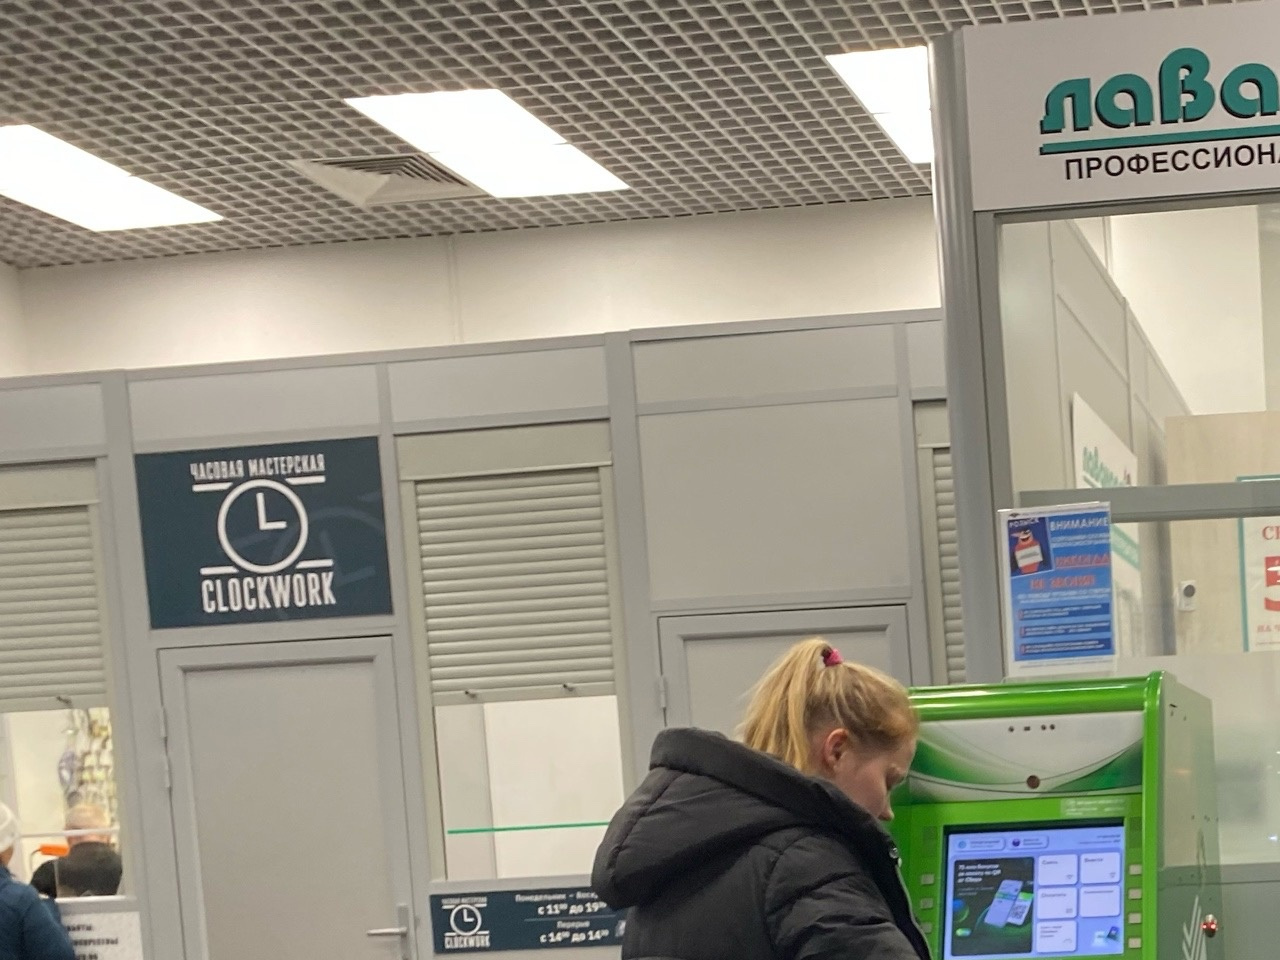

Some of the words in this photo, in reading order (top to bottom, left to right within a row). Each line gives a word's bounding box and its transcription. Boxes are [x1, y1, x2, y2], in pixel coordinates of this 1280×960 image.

[190, 460, 245, 480] ЧАСОВАЯ
[248, 454, 326, 477] МАСТЕРСКАЯ
[201, 572, 336, 613] CLOCKWORK
